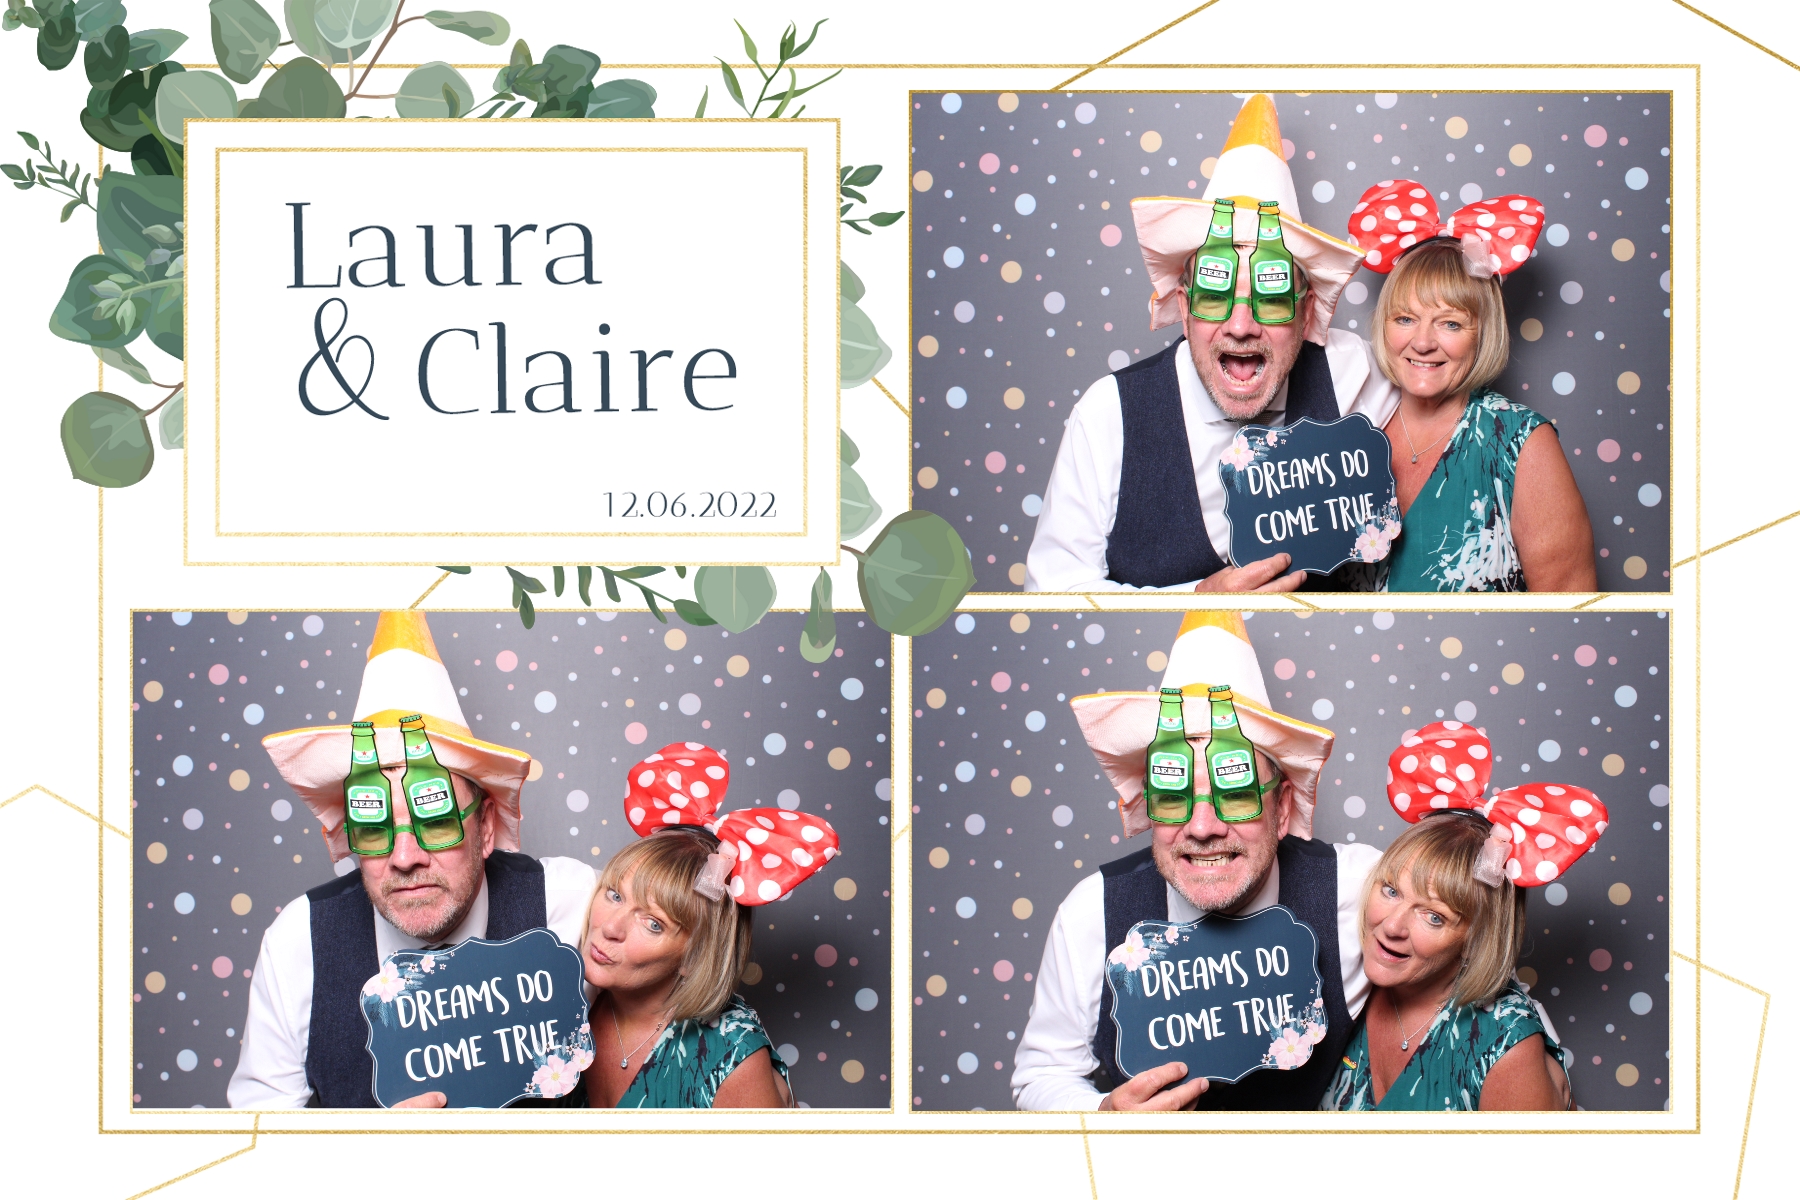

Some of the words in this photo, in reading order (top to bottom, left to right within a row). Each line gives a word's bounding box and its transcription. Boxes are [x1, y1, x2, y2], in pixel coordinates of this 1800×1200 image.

[1200, 267, 1228, 279] BEER
[1259, 273, 1286, 281] BEER
[1247, 453, 1337, 498] DREAMS
[1340, 449, 1369, 478] DO
[1254, 504, 1319, 544] COME
[1323, 492, 1377, 532] TRUE
[1153, 766, 1183, 776] BEER
[1217, 764, 1248, 775] BEER
[351, 800, 382, 809] BEER
[416, 792, 446, 805] BEER
[1140, 950, 1249, 1001] DREAMS
[1255, 945, 1290, 978] DO
[396, 976, 510, 1032] DREAMS
[516, 969, 554, 1004] DO
[1148, 1006, 1226, 1051] COME
[1232, 993, 1298, 1037] TRUE
[404, 1035, 487, 1082] COME
[493, 1019, 563, 1065] TRUE
